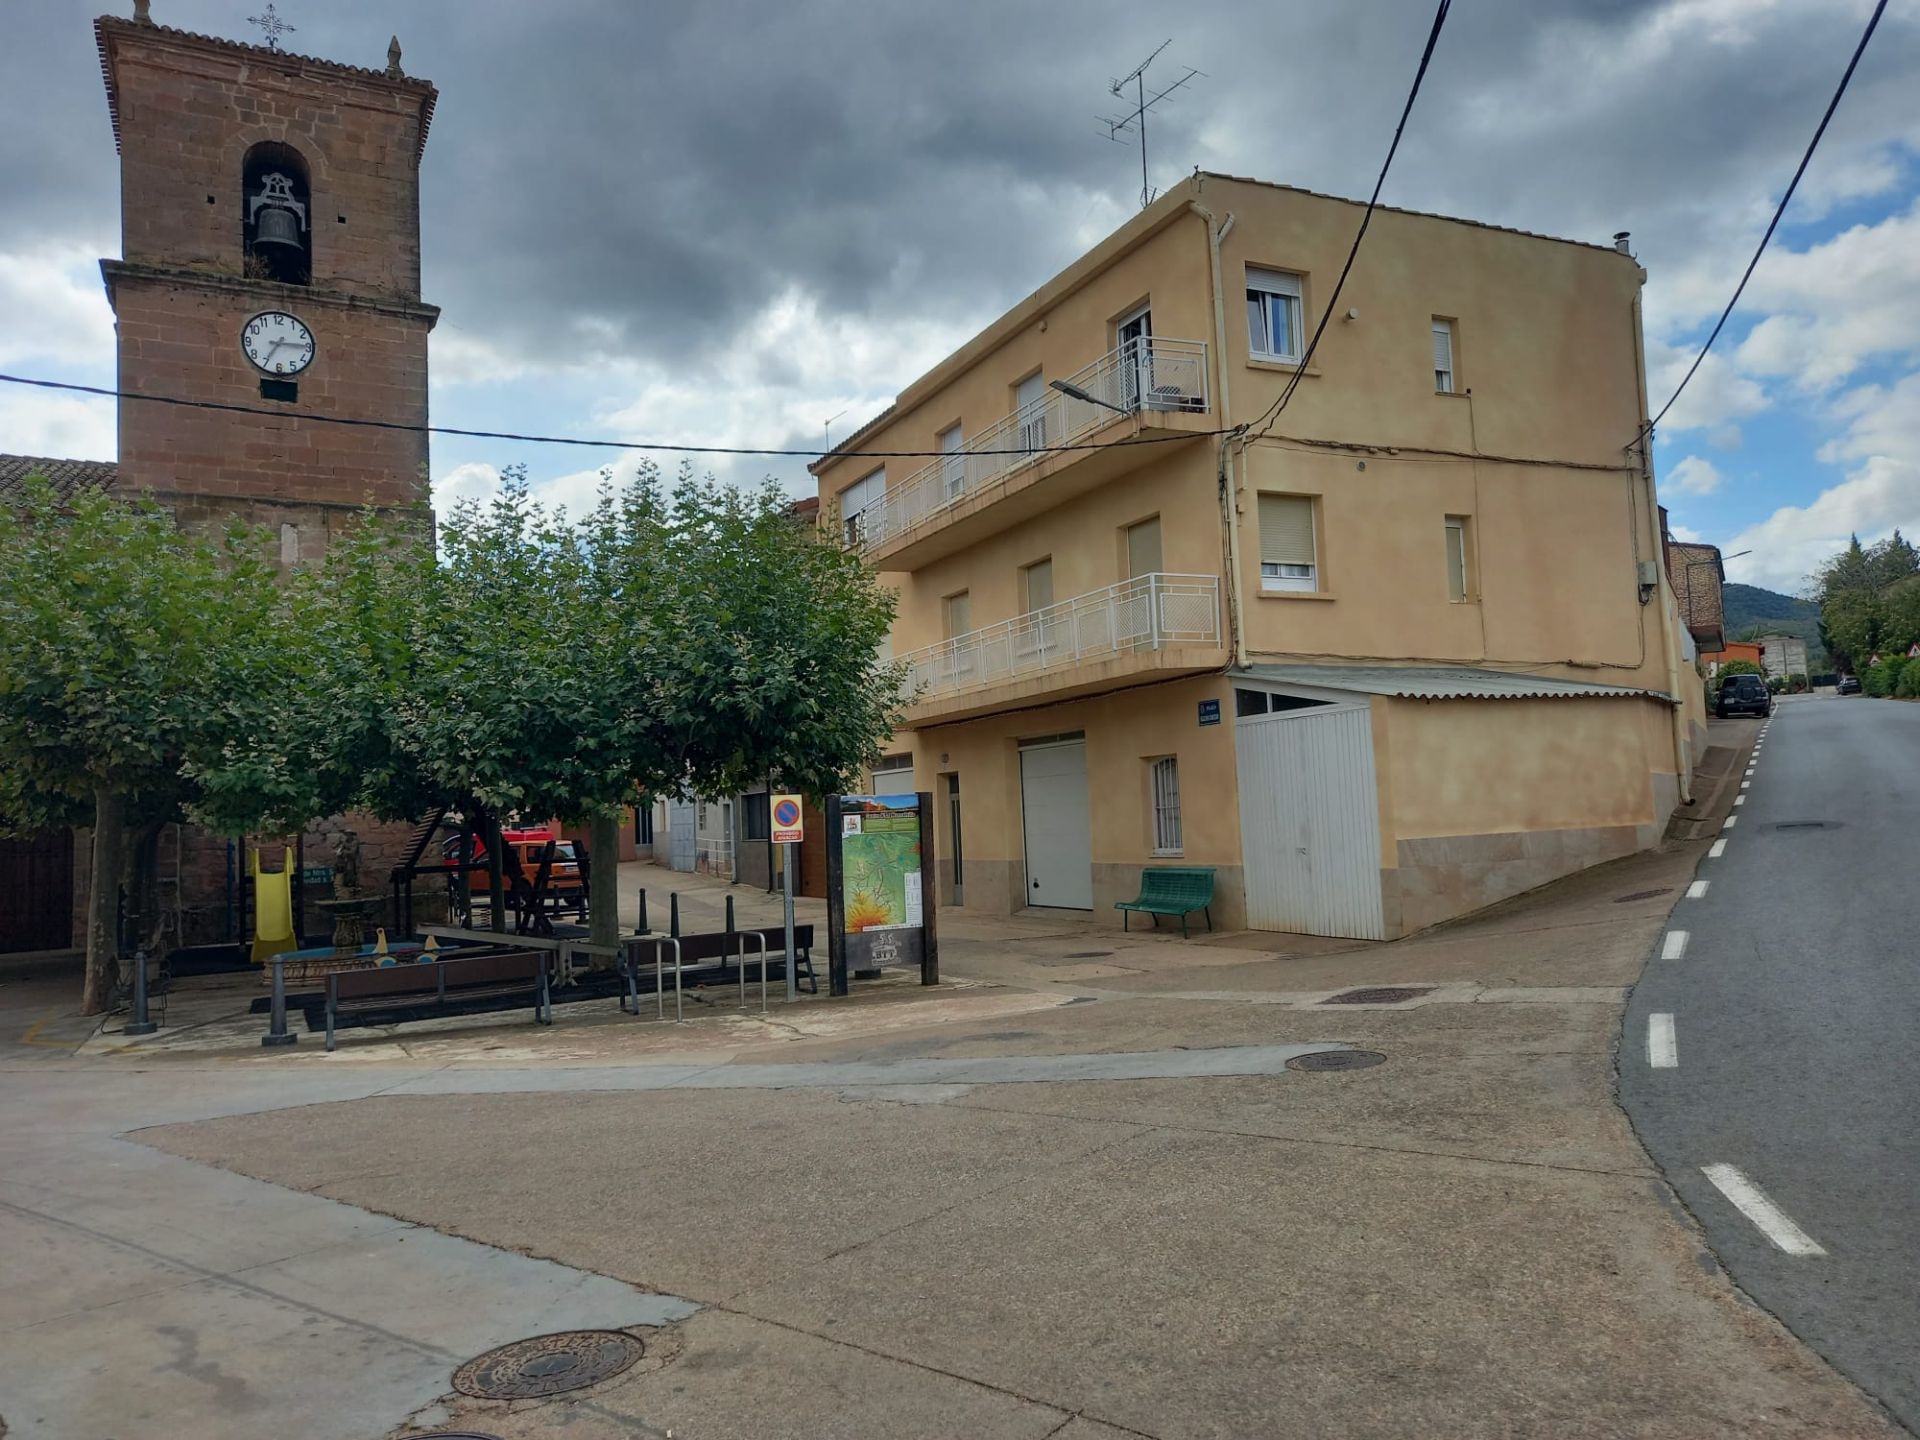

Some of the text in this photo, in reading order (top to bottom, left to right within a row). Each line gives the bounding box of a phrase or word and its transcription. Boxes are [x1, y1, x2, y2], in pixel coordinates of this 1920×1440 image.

[260, 318, 267, 328] 11
[274, 315, 284, 325] 12
[291, 320, 295, 330] 1
[250, 325, 260, 335] 10
[299, 329, 306, 339] 2
[245, 336, 251, 346] 9
[305, 343, 311, 352] 3
[251, 349, 257, 359] 8
[263, 357, 269, 367] 7
[290, 361, 296, 371] 5
[276, 363, 282, 373] 6
